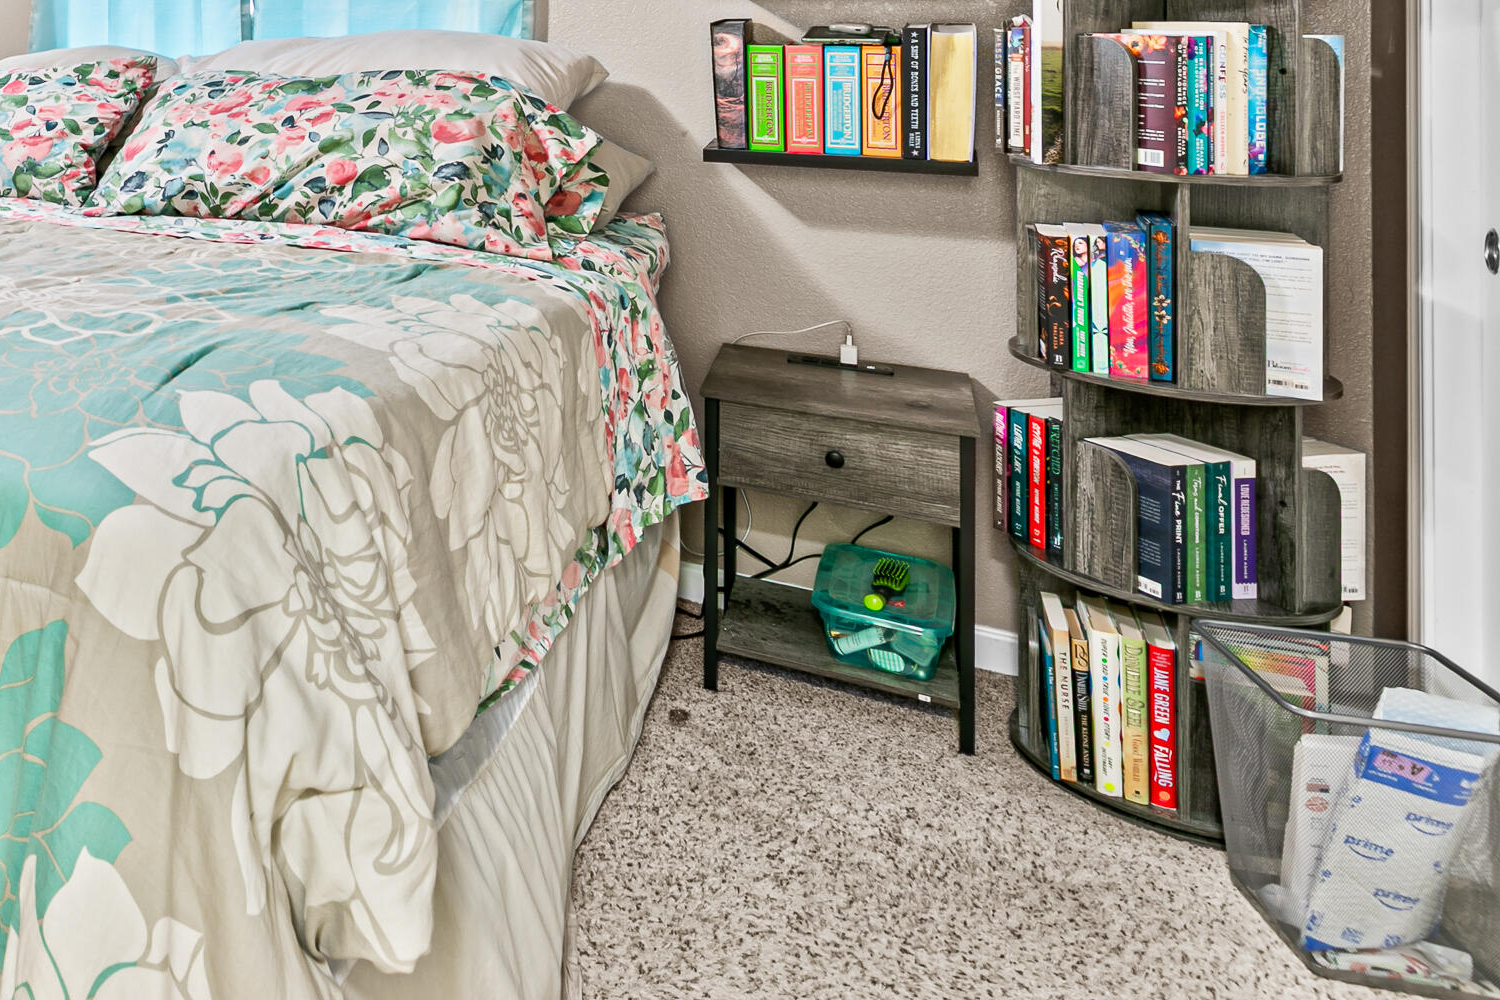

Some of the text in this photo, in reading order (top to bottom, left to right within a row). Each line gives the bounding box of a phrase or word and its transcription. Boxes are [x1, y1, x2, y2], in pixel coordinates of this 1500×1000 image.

[910, 45, 919, 59] SHIP
[910, 60, 919, 70] OF
[994, 33, 1003, 100] MESSY GRACE
[910, 71, 919, 92] BONES
[1218, 44, 1227, 99] CONFESS
[765, 81, 773, 137] BRIDGERTON
[804, 82, 813, 138] BRIDGERTON
[842, 82, 853, 139] BRIDGERTON
[910, 93, 919, 107] AND
[1013, 76, 1021, 137] WORST HARD TIME
[1255, 68, 1268, 150] SNOWGLOBE
[910, 108, 919, 129] TEETH
[1050, 247, 1068, 285] Rhapsodic
[1014, 455, 1022, 475] LARK
[1051, 424, 1061, 476] WRETCHED
[1171, 491, 1186, 518] Fine
[1193, 497, 1203, 512] and
[1215, 474, 1228, 506] Final
[1240, 484, 1250, 499] LOVE
[1174, 519, 1183, 544] PRINT
[1240, 499, 1250, 536] REDESIGNED
[1059, 651, 1067, 671] THE
[1125, 643, 1143, 696] DANIELLE
[1060, 675, 1070, 710] NURSE
[1153, 667, 1170, 691] JANE
[1126, 696, 1146, 728] STEEL
[1153, 692, 1171, 725] GREEN
[1152, 743, 1173, 788] FALLING
[1343, 835, 1395, 858] prime
